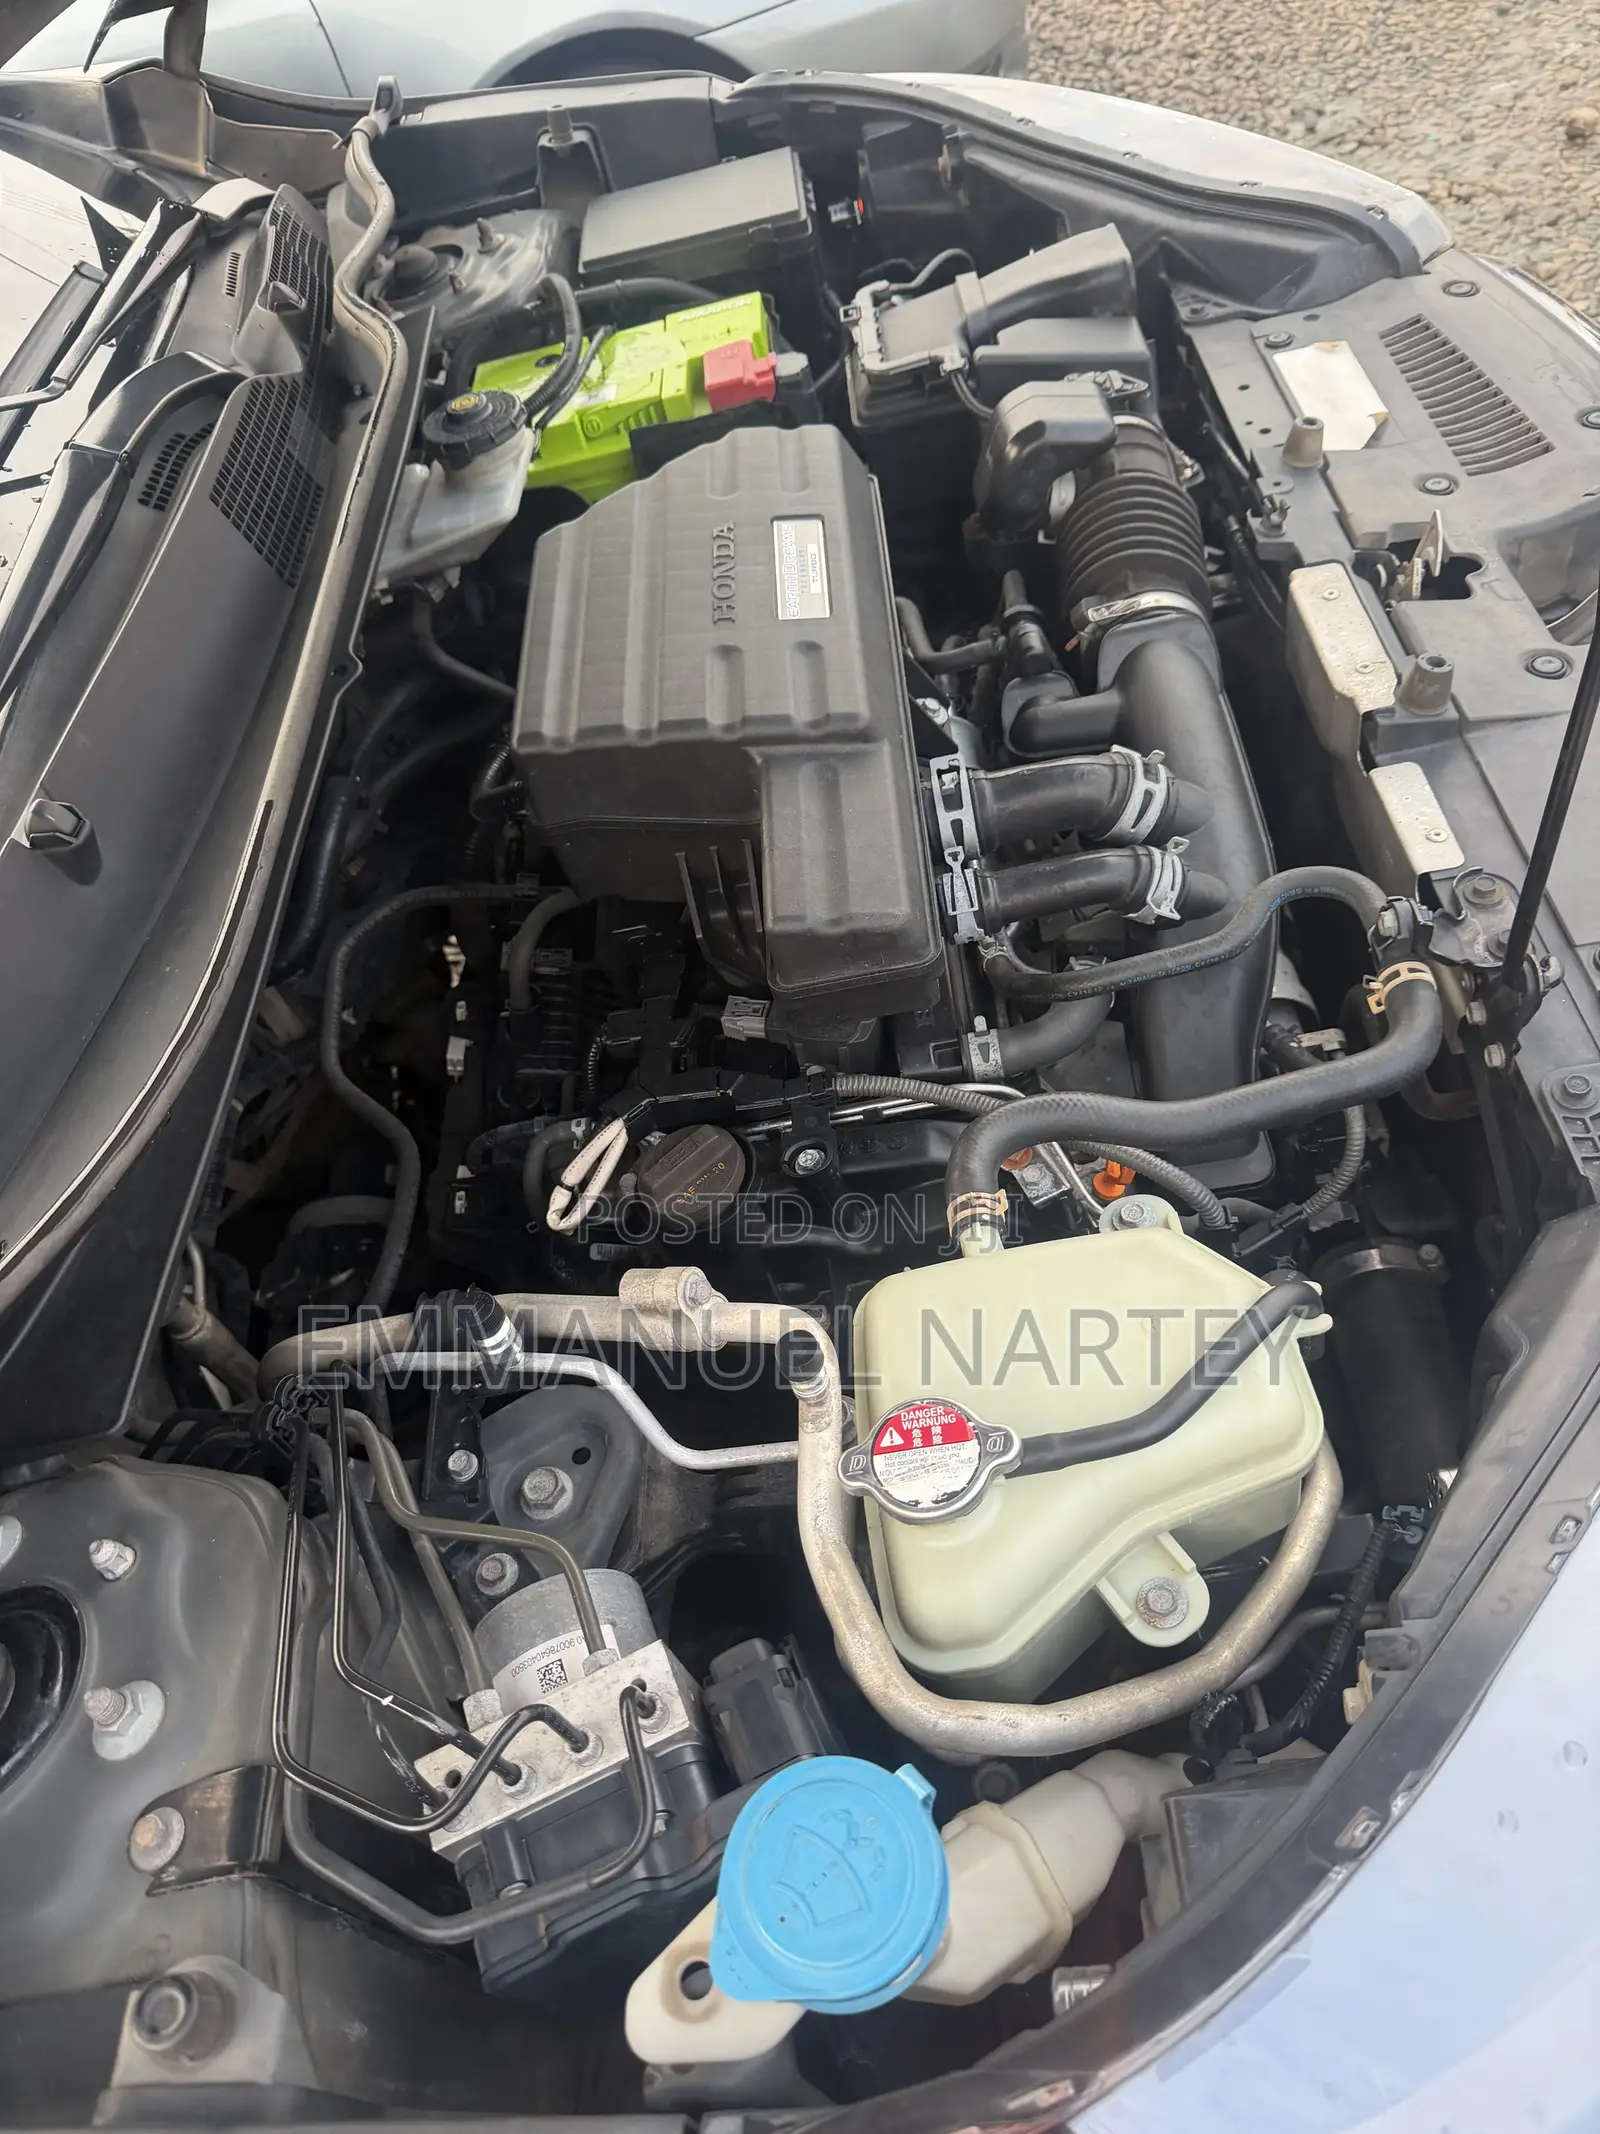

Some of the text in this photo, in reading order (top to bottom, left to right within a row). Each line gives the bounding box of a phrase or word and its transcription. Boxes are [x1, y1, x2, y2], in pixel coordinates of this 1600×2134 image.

[711, 520, 736, 625] HONDA
[781, 523, 800, 619] EARTH DREAMS
[809, 553, 819, 584] TURBO
[900, 1406, 946, 1421] DANGER
[901, 1414, 957, 1430] WARNUNG
[884, 1443, 968, 1461] NEVER OPEN WHEN HOT.
